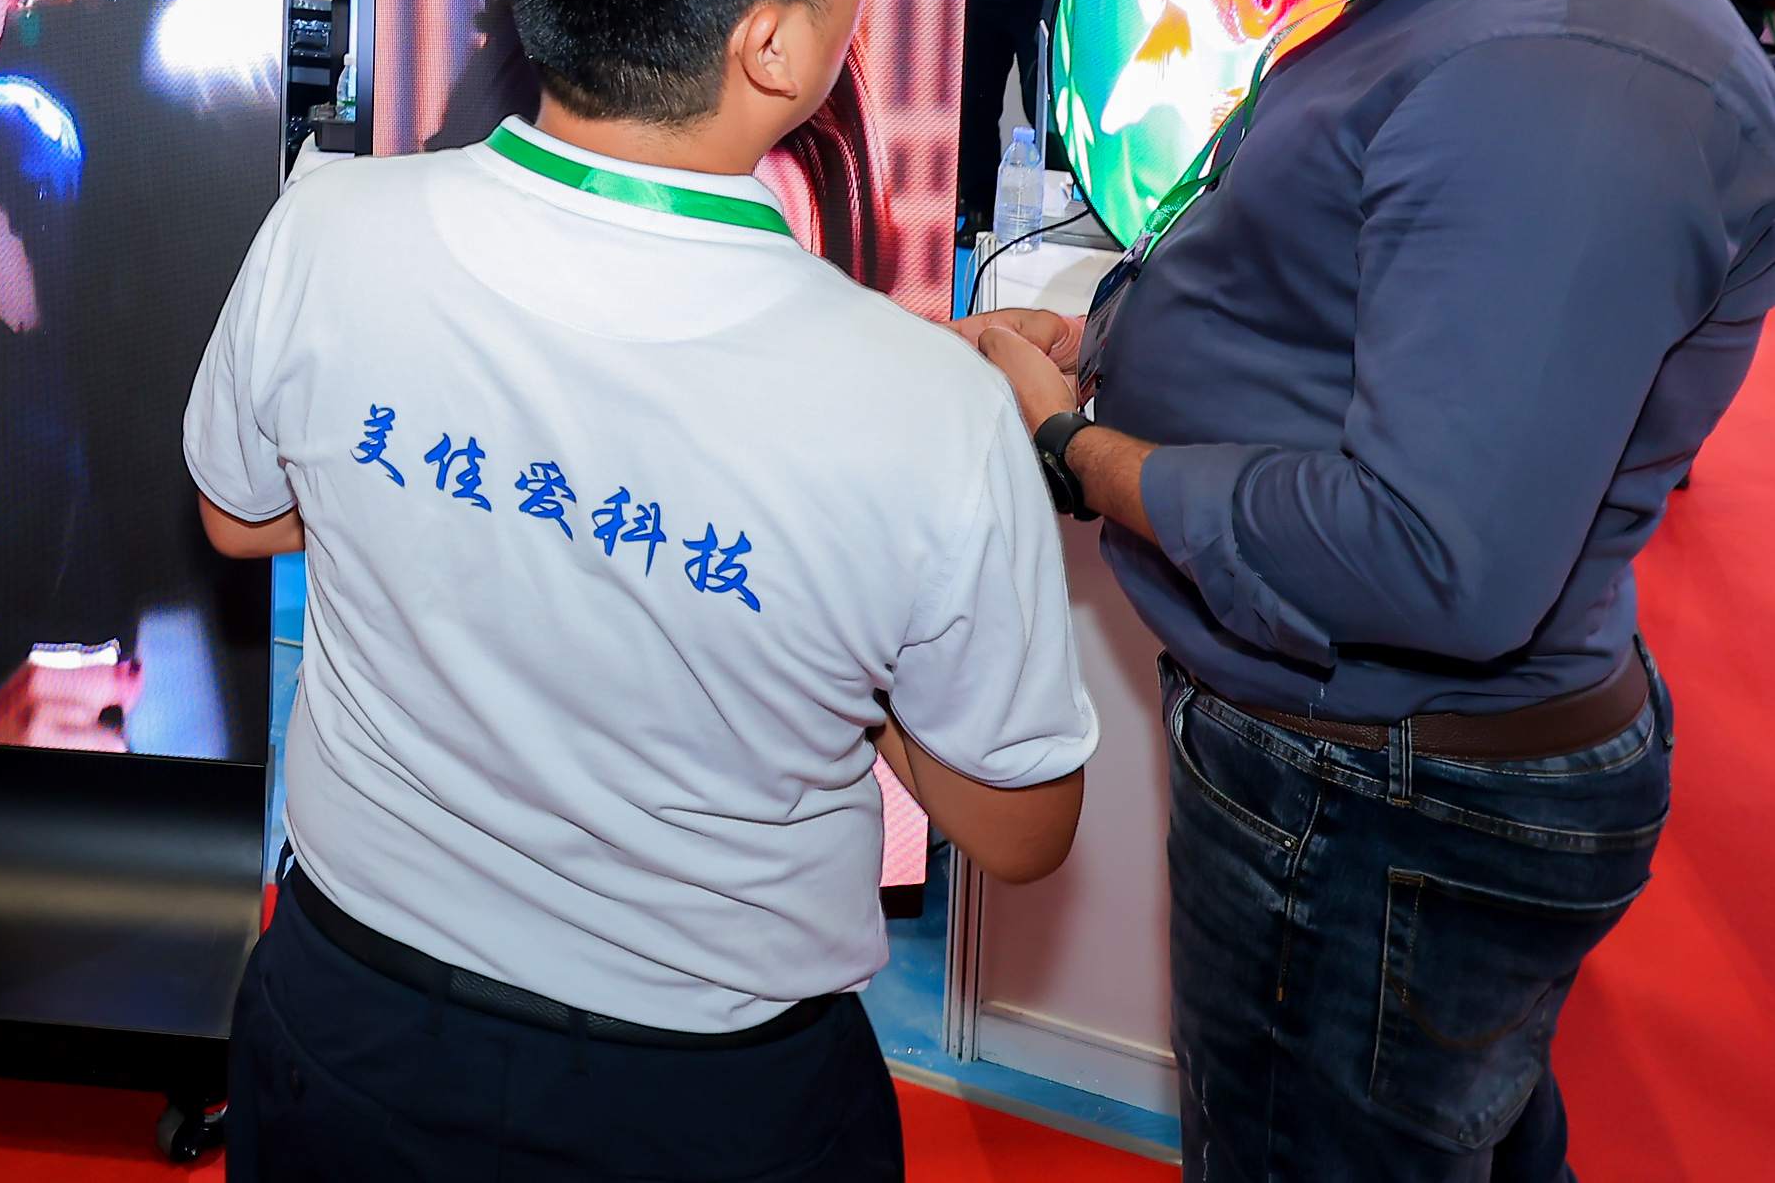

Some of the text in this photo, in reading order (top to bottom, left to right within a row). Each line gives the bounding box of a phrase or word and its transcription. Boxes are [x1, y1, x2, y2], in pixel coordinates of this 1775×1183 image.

[349, 403, 761, 613] 美佳爱科技
